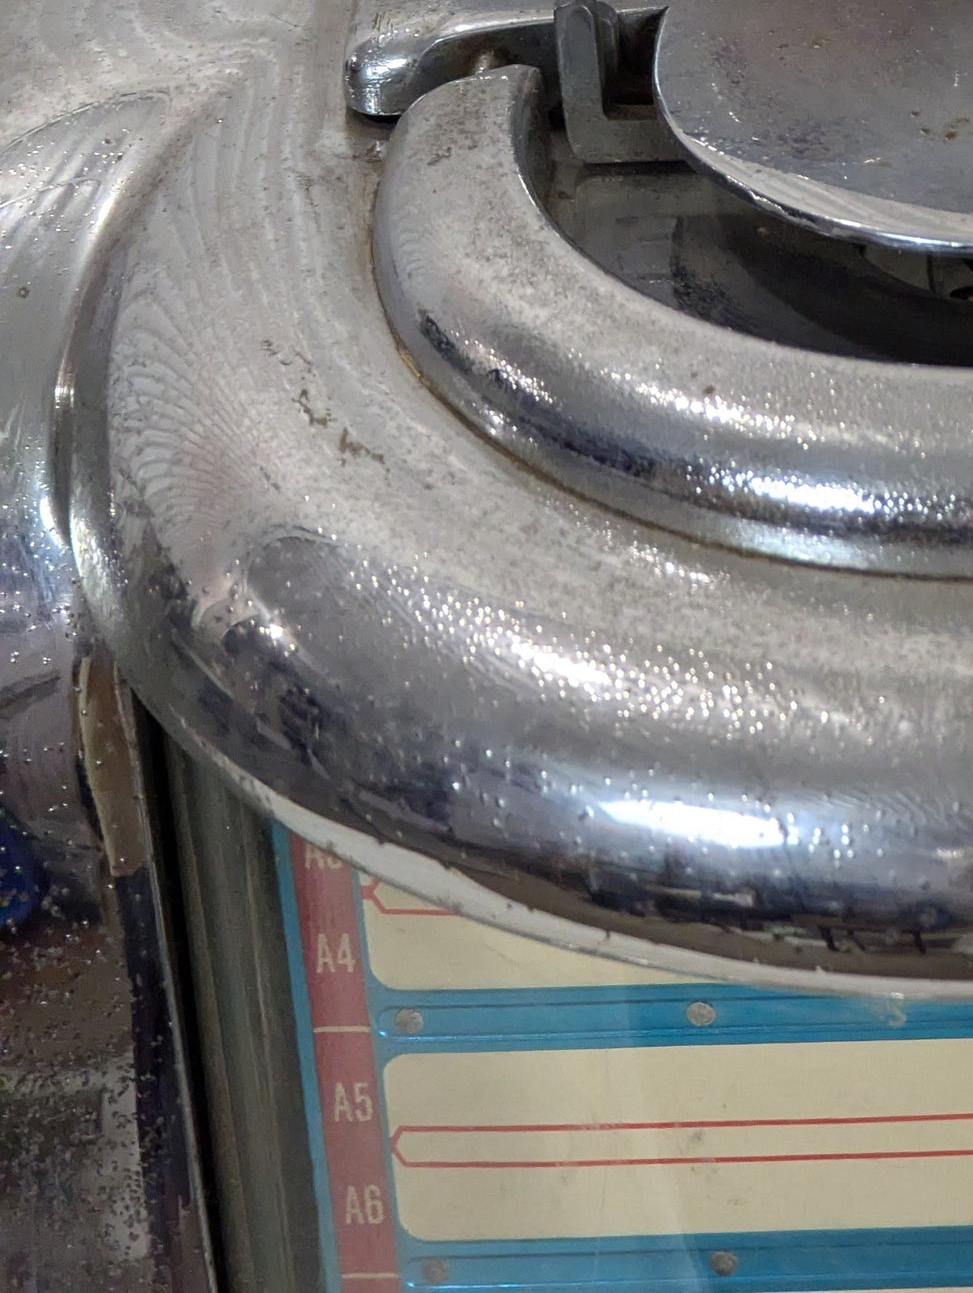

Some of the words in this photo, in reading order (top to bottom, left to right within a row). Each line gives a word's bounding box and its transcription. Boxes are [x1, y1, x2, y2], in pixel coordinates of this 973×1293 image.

[315, 933, 356, 973] A4
[333, 1082, 373, 1122] A5
[345, 1185, 384, 1226] A6
